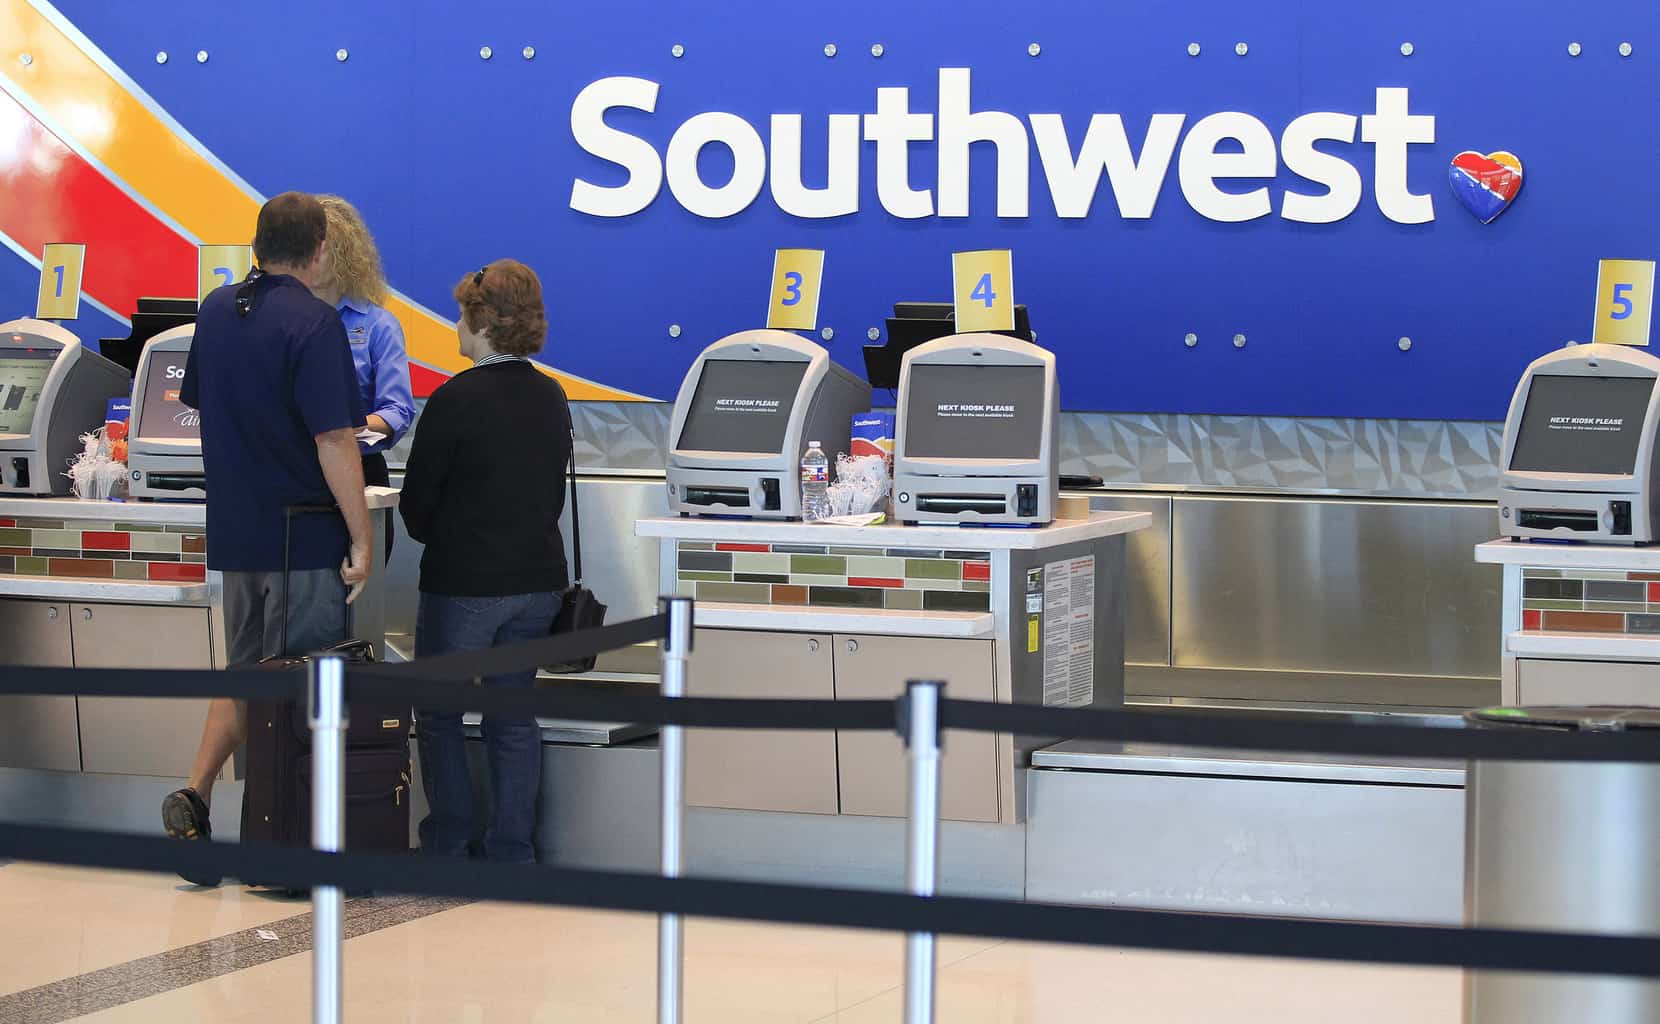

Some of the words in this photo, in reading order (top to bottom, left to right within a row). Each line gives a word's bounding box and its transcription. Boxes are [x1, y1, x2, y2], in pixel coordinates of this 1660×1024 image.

[569, 67, 1436, 225] Southwest
[53, 265, 65, 297] 1
[781, 272, 803, 306] 3
[970, 273, 997, 308] 4
[1610, 283, 1634, 320] 5
[1571, 417, 1595, 425] KIOSK
